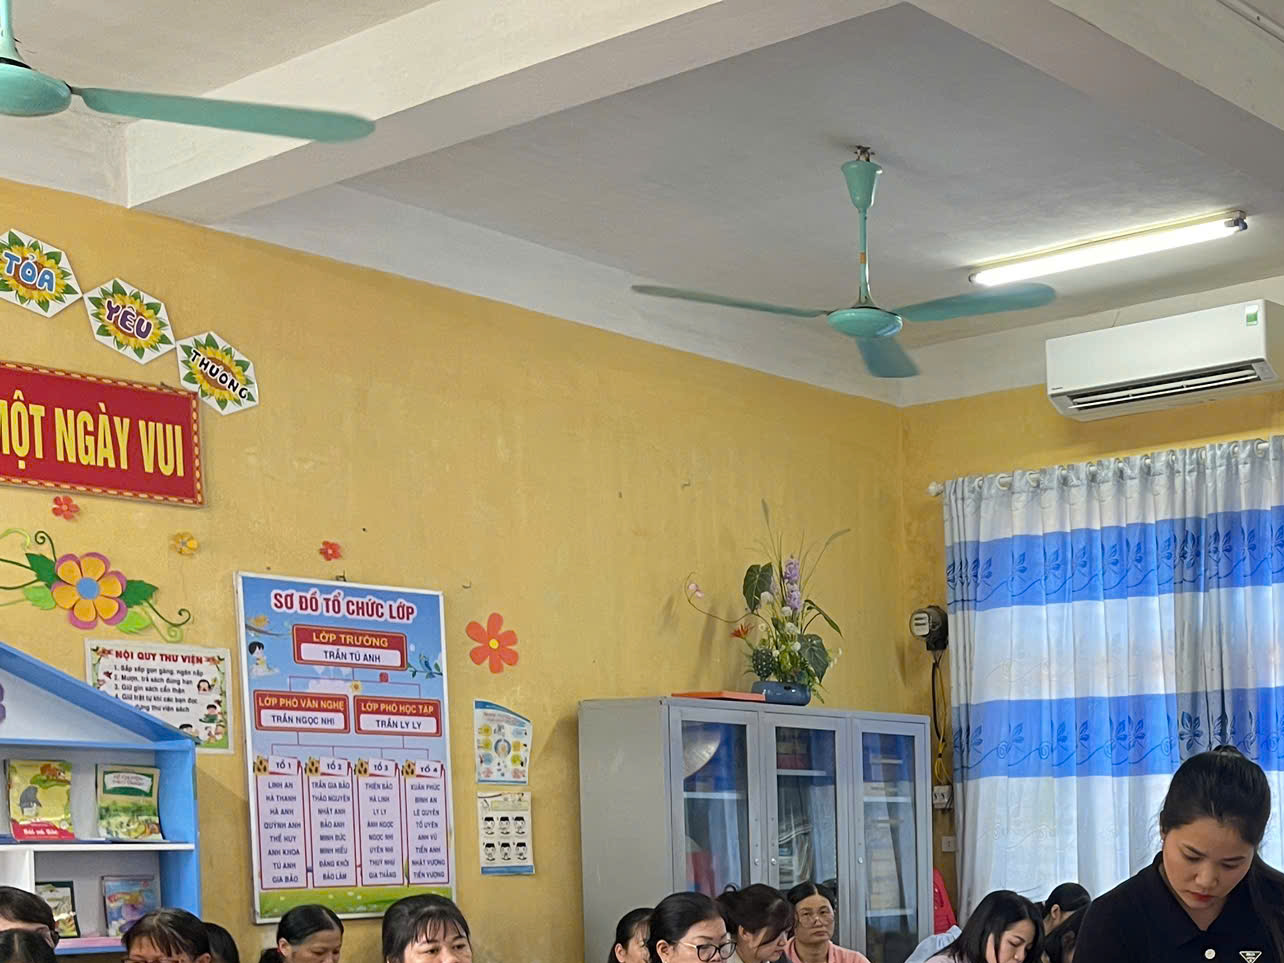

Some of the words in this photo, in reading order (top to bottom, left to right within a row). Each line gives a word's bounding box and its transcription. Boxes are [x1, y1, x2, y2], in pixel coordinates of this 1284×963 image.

[4, 252, 54, 292] TỎA
[106, 300, 152, 339] YÊU
[190, 350, 248, 399] THƯƠNG
[54, 402, 130, 470] NGÀY
[138, 419, 184, 477] VUI
[274, 592, 294, 610] SƠ
[346, 598, 385, 619] CHỨC
[388, 601, 415, 621] LỚP
[312, 631, 337, 643] LỚP
[115, 649, 134, 661] NỘI
[137, 651, 157, 661] QUY
[181, 654, 203, 665] VIỆN
[363, 653, 381, 663] ANH
[258, 696, 278, 707] LỚP
[361, 701, 379, 711] LỚP
[295, 715, 318, 725] NGỌC
[321, 717, 335, 725] NHI
[400, 721, 410, 729] LY
[412, 721, 422, 729] LY
